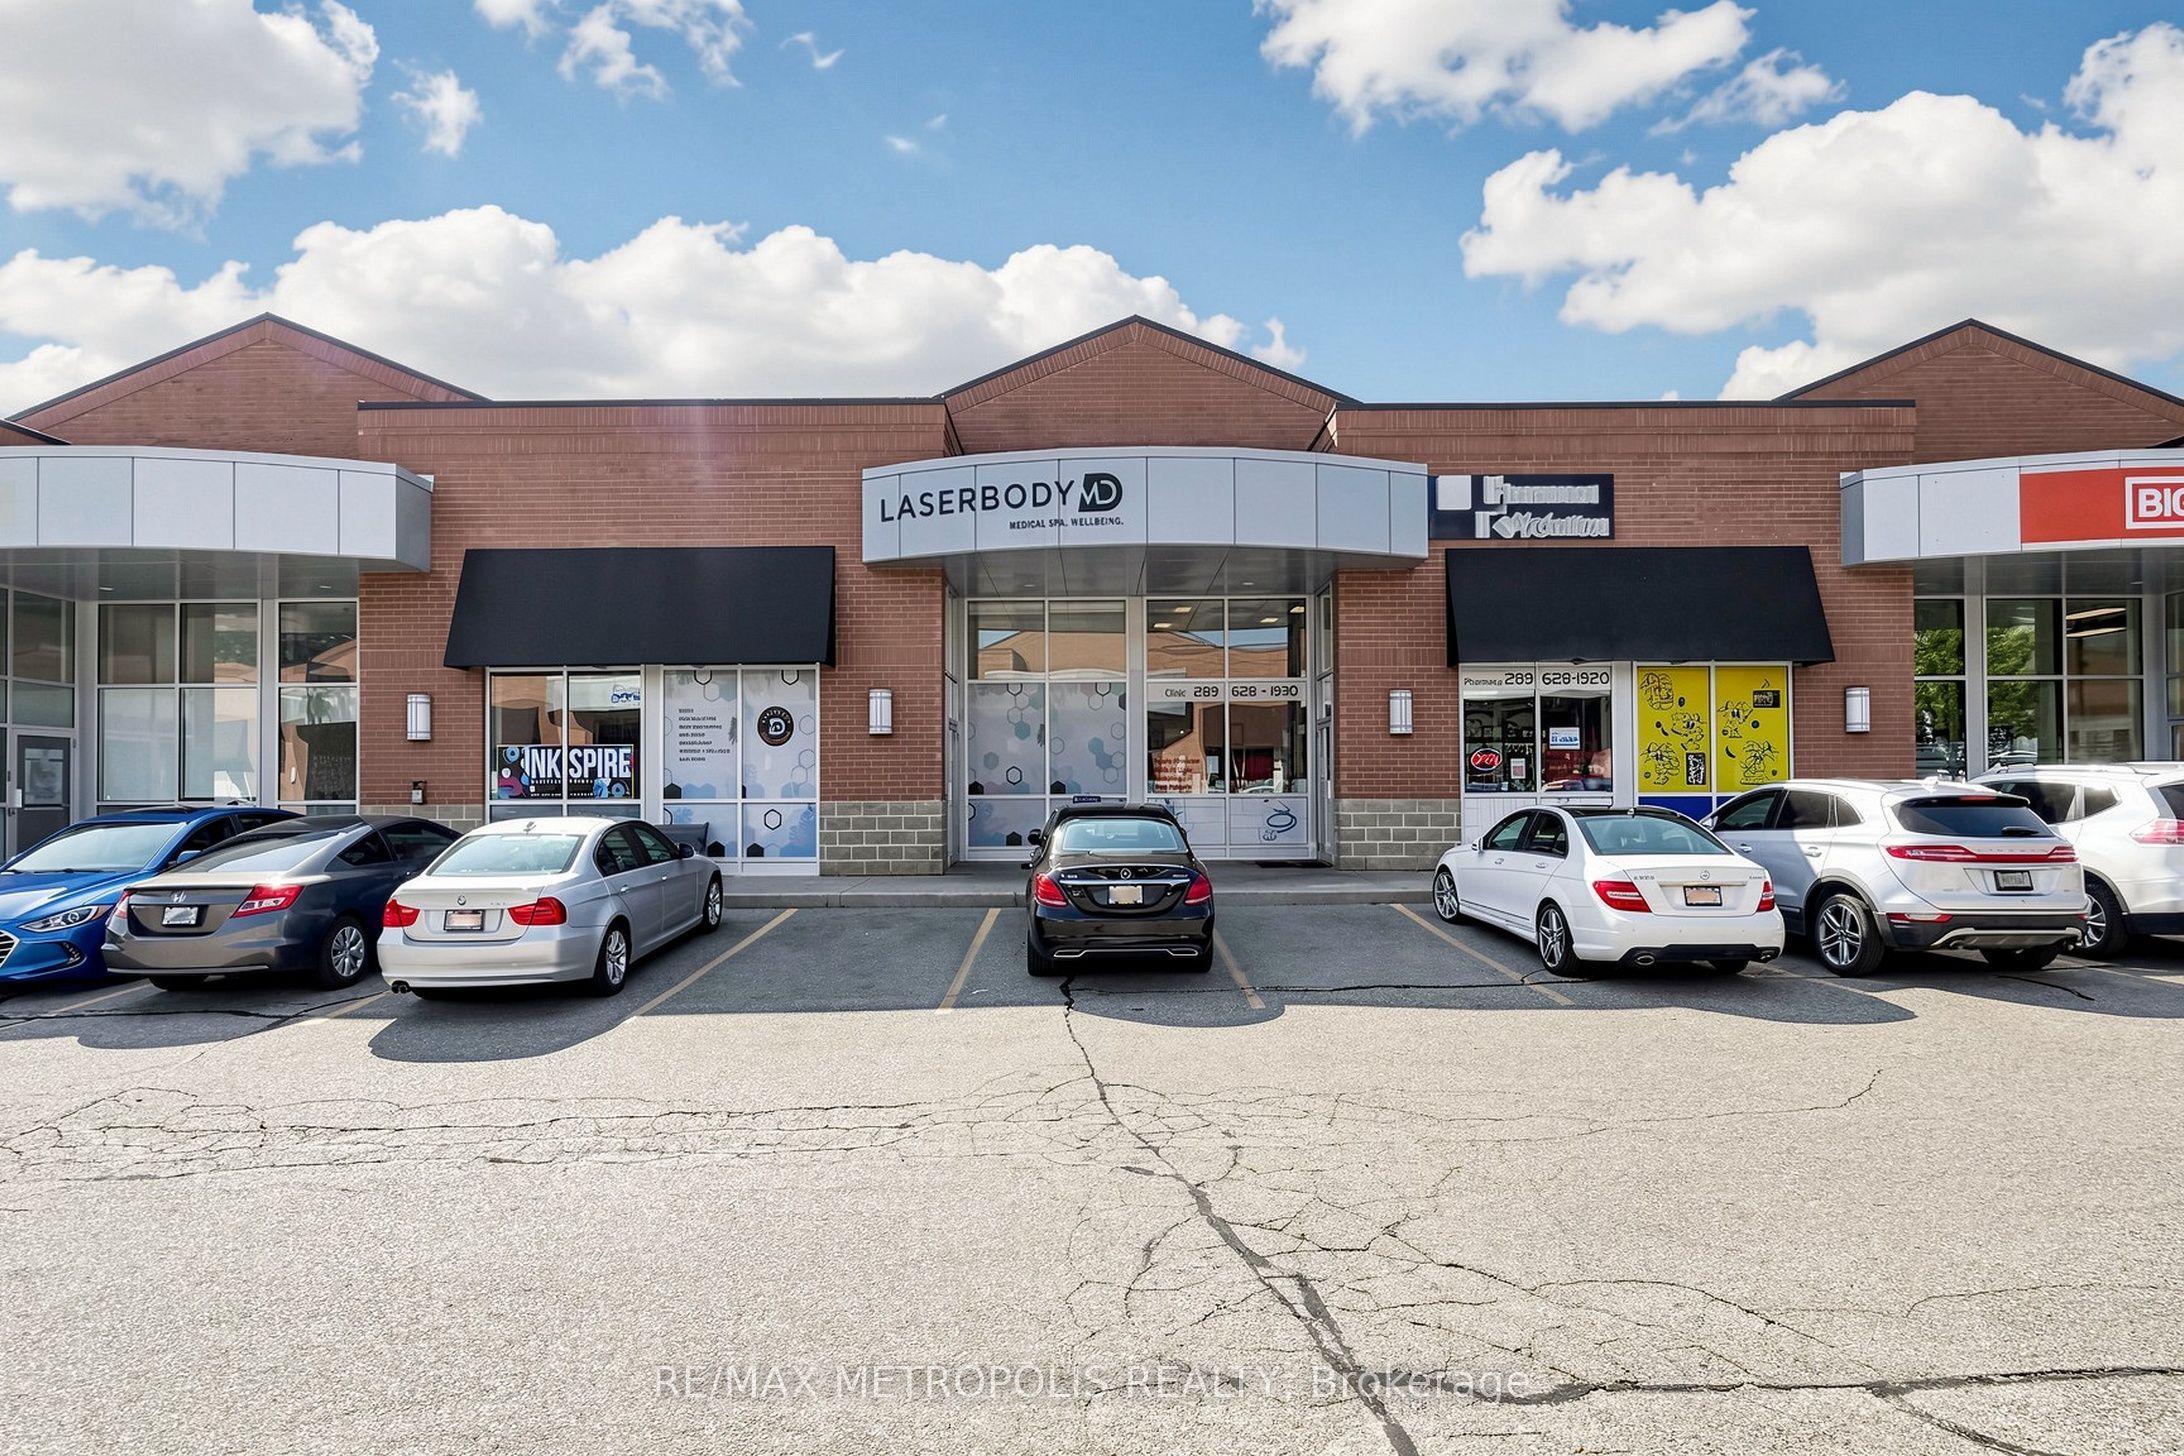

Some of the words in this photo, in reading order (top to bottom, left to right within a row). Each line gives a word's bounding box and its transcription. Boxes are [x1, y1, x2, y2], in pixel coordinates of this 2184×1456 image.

[880, 480, 1075, 523] LASERBODY
[1009, 520, 1046, 530] MEDICAL
[1048, 518, 1068, 528] SPA.
[1071, 516, 1124, 527] WELLBEING.
[1504, 672, 1534, 685] 289
[1541, 671, 1610, 685] 628-1920
[1193, 685, 1219, 697] 289
[1231, 685, 1257, 697] 628
[1270, 684, 1299, 697] 1930
